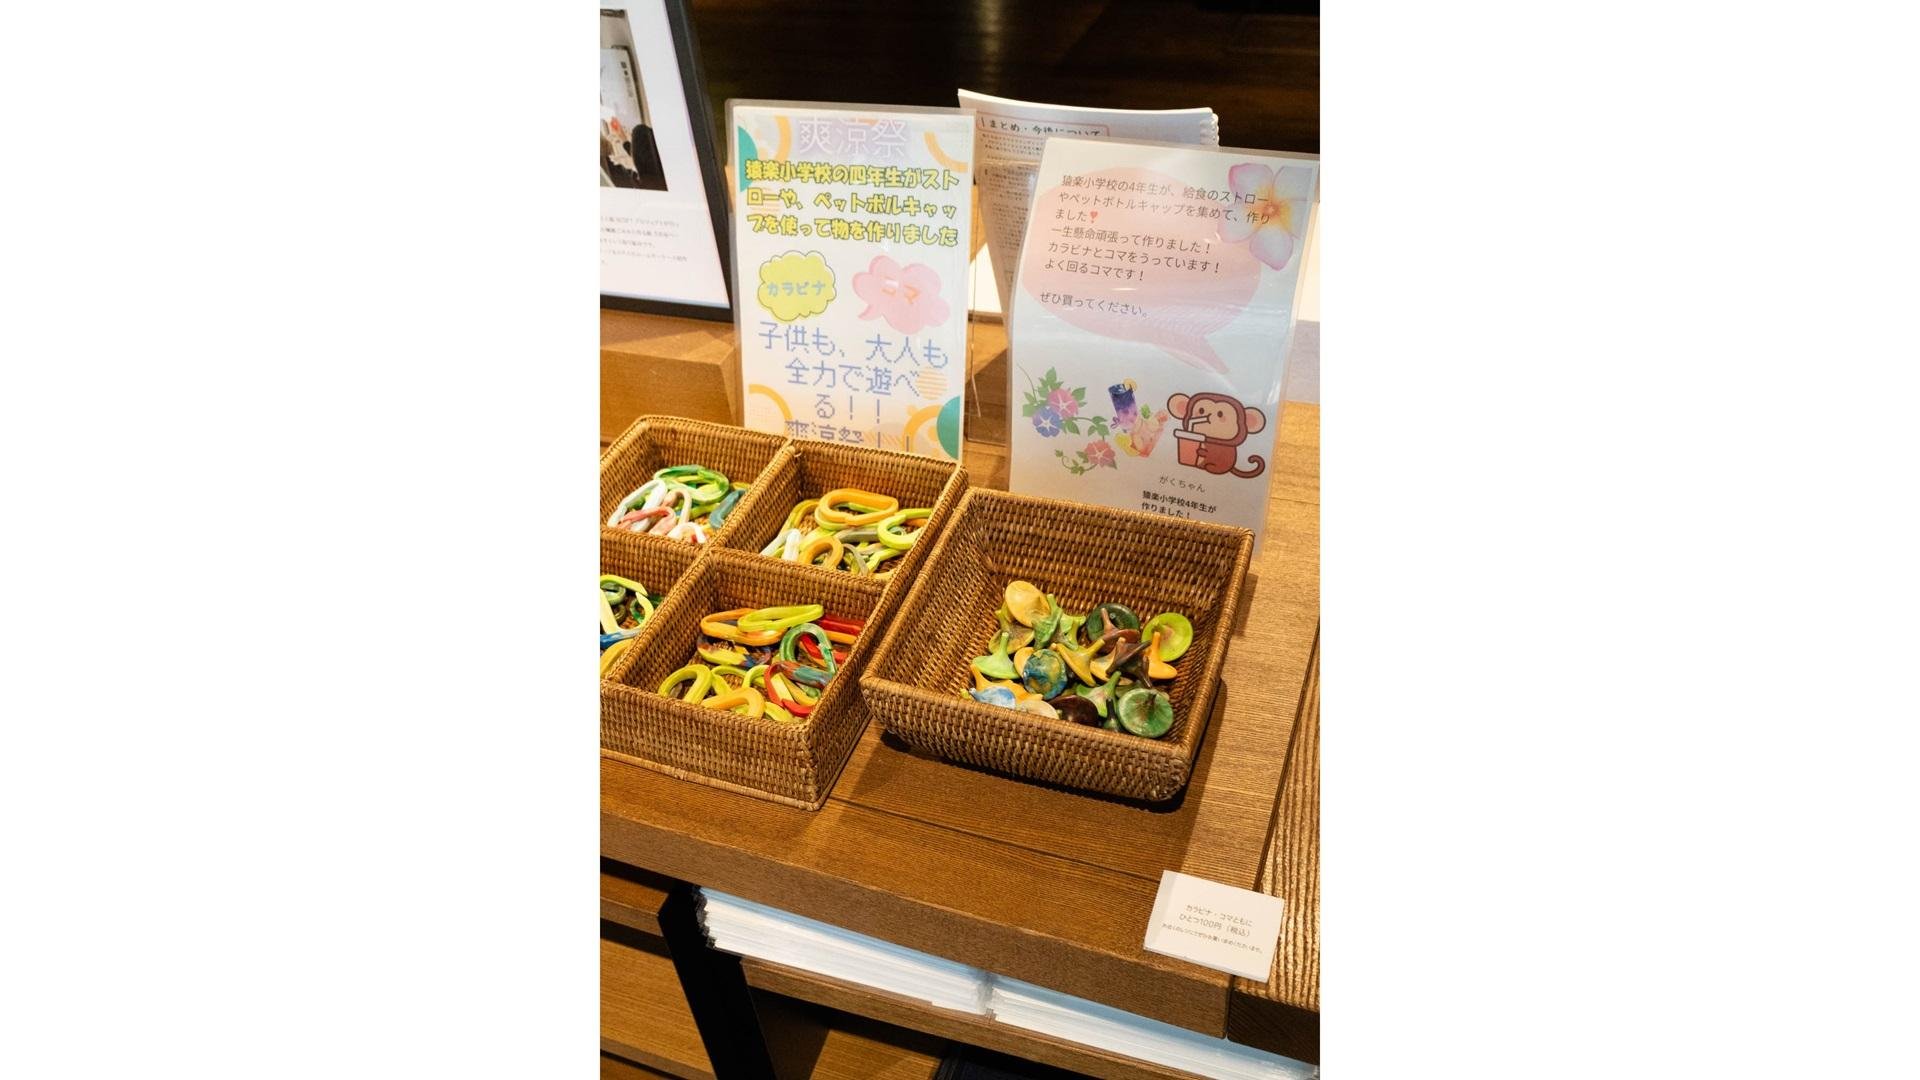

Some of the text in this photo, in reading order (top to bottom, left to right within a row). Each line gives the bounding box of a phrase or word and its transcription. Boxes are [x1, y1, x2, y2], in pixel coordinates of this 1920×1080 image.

[798, 116, 907, 158] 爽涼祭
[745, 160, 960, 190] 猿楽小学校の四年生がスト
[1051, 226, 1211, 254] 一生懸命頑張って作りました！
[1044, 258, 1145, 281] よく回るコマです！
[1047, 242, 1220, 274] カラビナとコマをうっています！
[767, 280, 827, 297] カラビナ
[881, 274, 920, 305] コマ
[1039, 292, 1150, 319] ぜひ買ってください。
[785, 357, 920, 397] 全力で遊べ
[1159, 475, 1205, 493] がくちゃん
[1142, 490, 1217, 514] 猿楽小学校4年生が
[1186, 904, 1253, 927] カラビナ・コマともに
